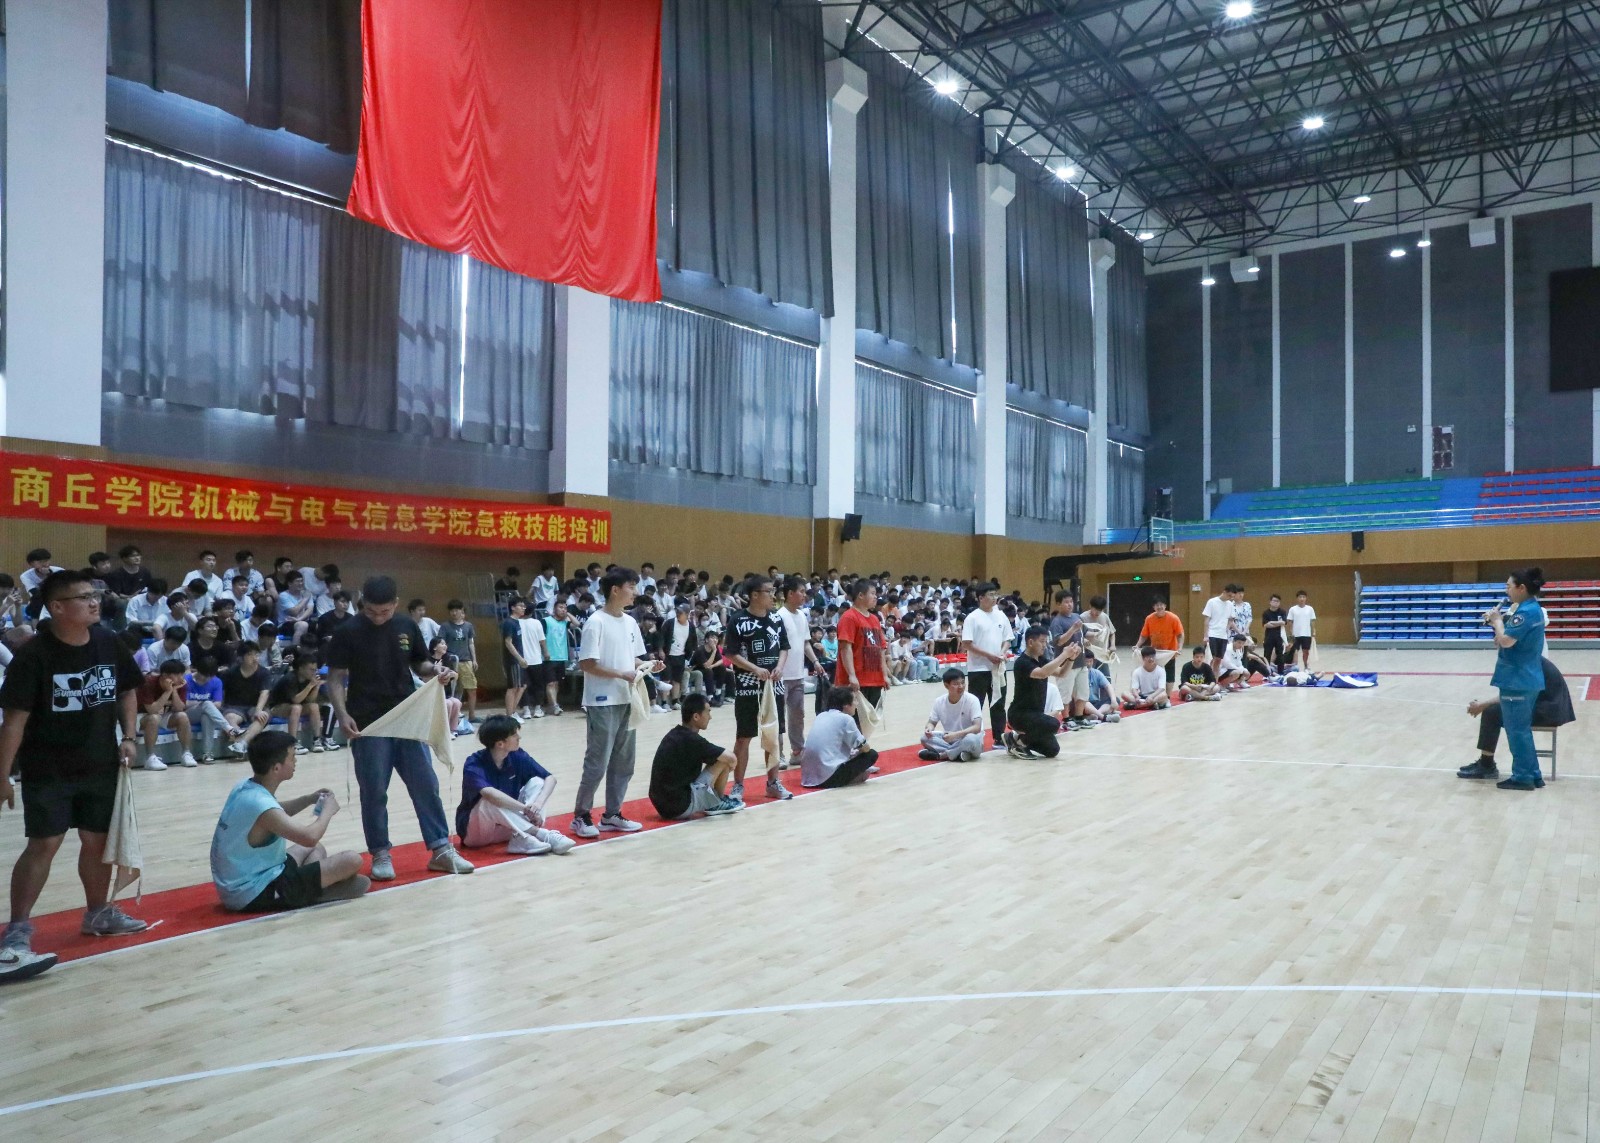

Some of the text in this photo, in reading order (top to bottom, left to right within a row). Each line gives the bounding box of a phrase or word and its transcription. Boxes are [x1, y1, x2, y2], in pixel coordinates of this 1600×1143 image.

[10, 467, 608, 546] 商丘学院机械与电气信息学院急救技能培训
[735, 619, 763, 635] MIX
